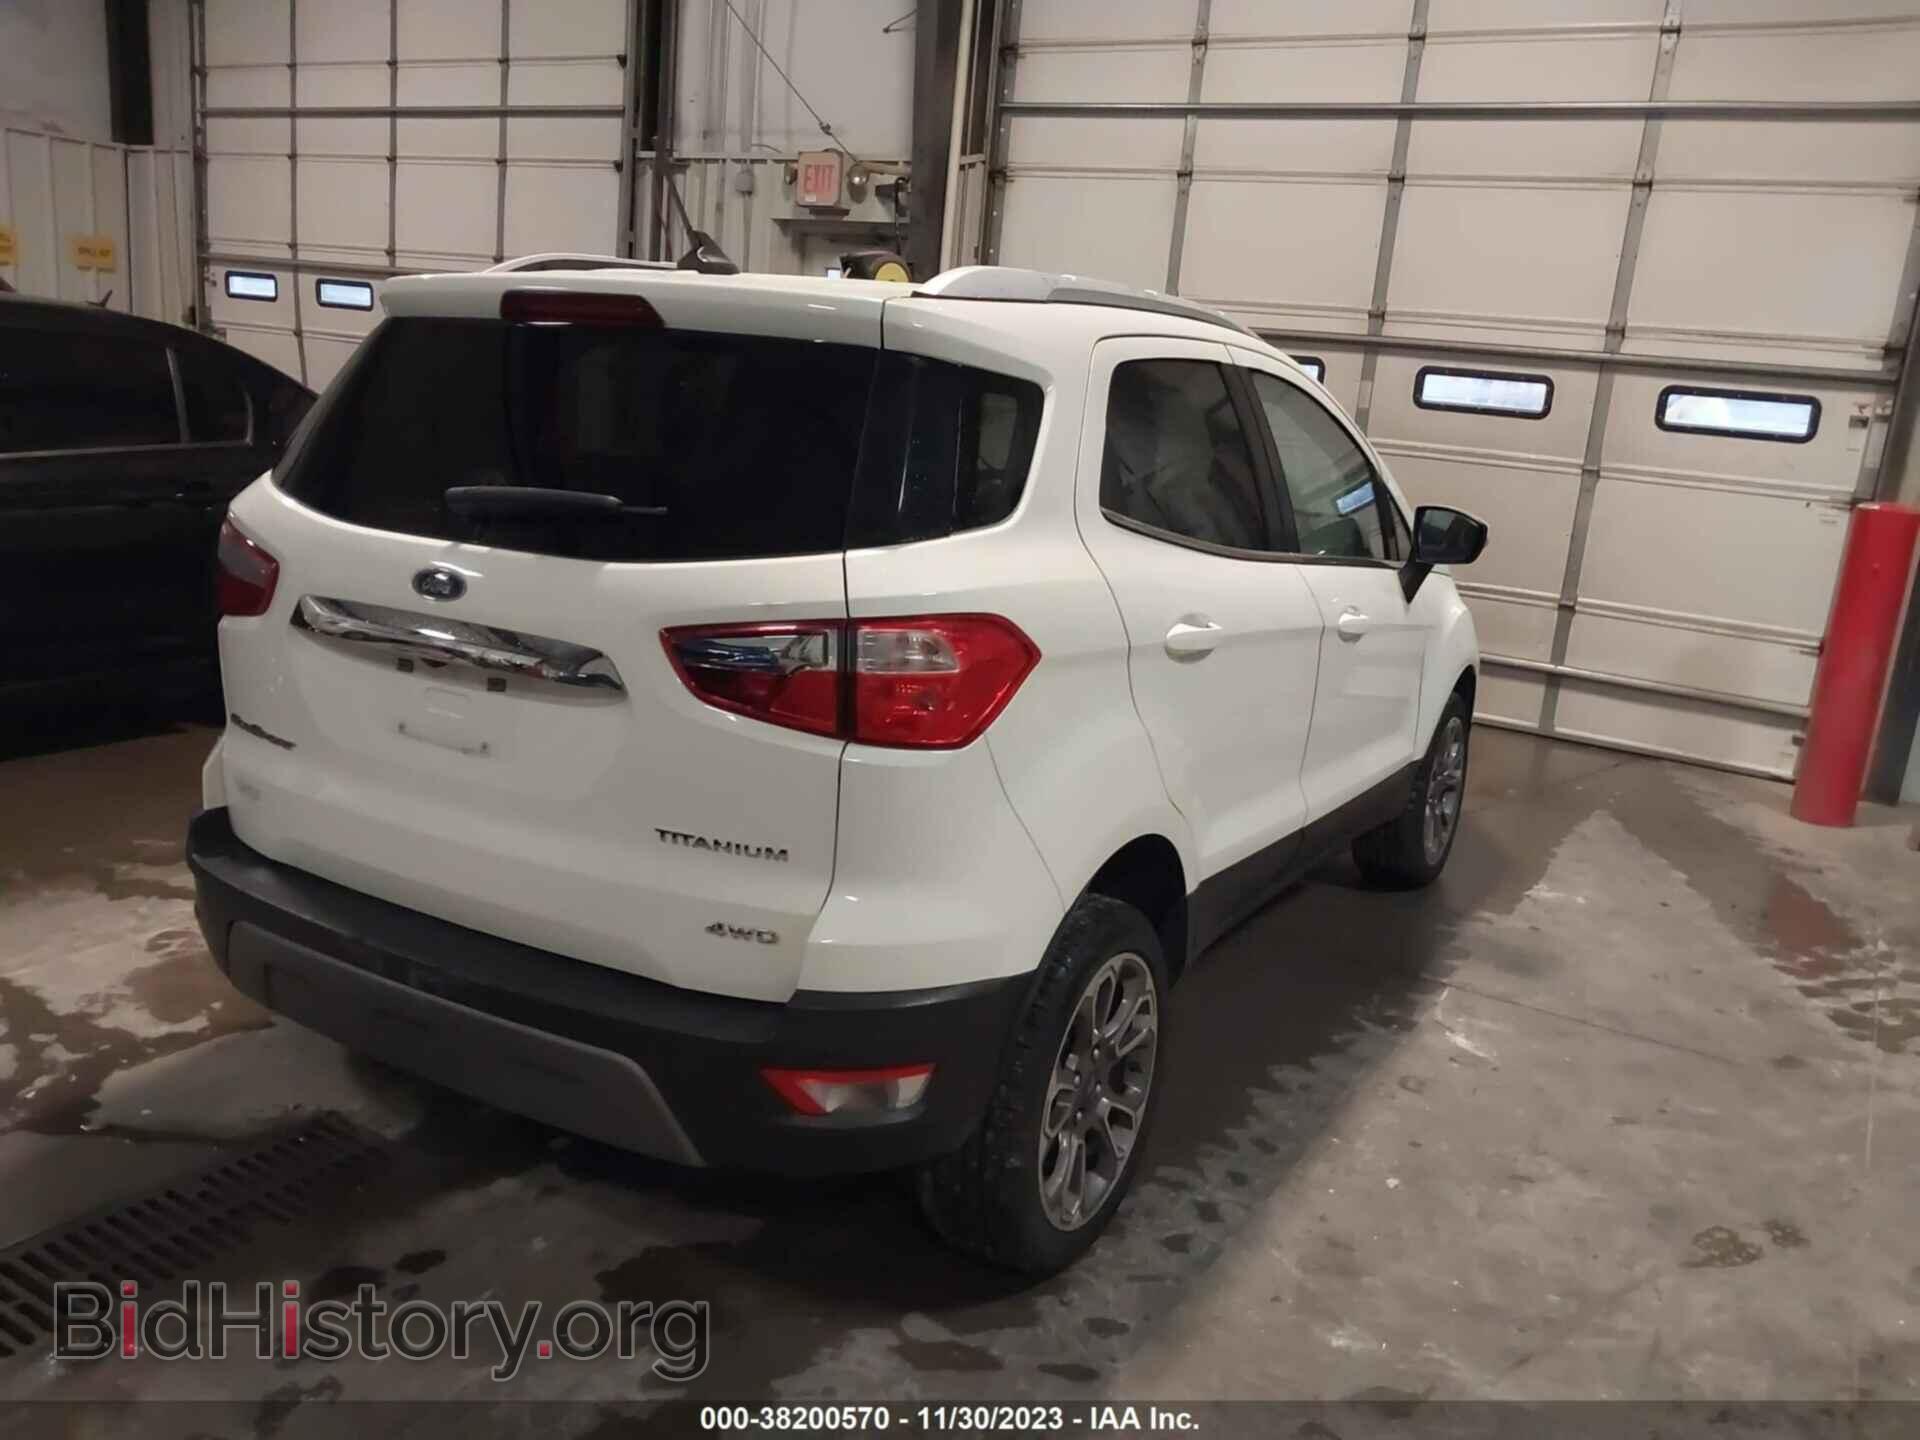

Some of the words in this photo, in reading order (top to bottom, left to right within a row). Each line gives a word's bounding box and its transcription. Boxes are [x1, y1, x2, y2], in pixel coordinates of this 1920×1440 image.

[803, 164, 835, 193] EXIT
[654, 827, 789, 863] TITANIUM
[704, 922, 779, 944] 4WD
